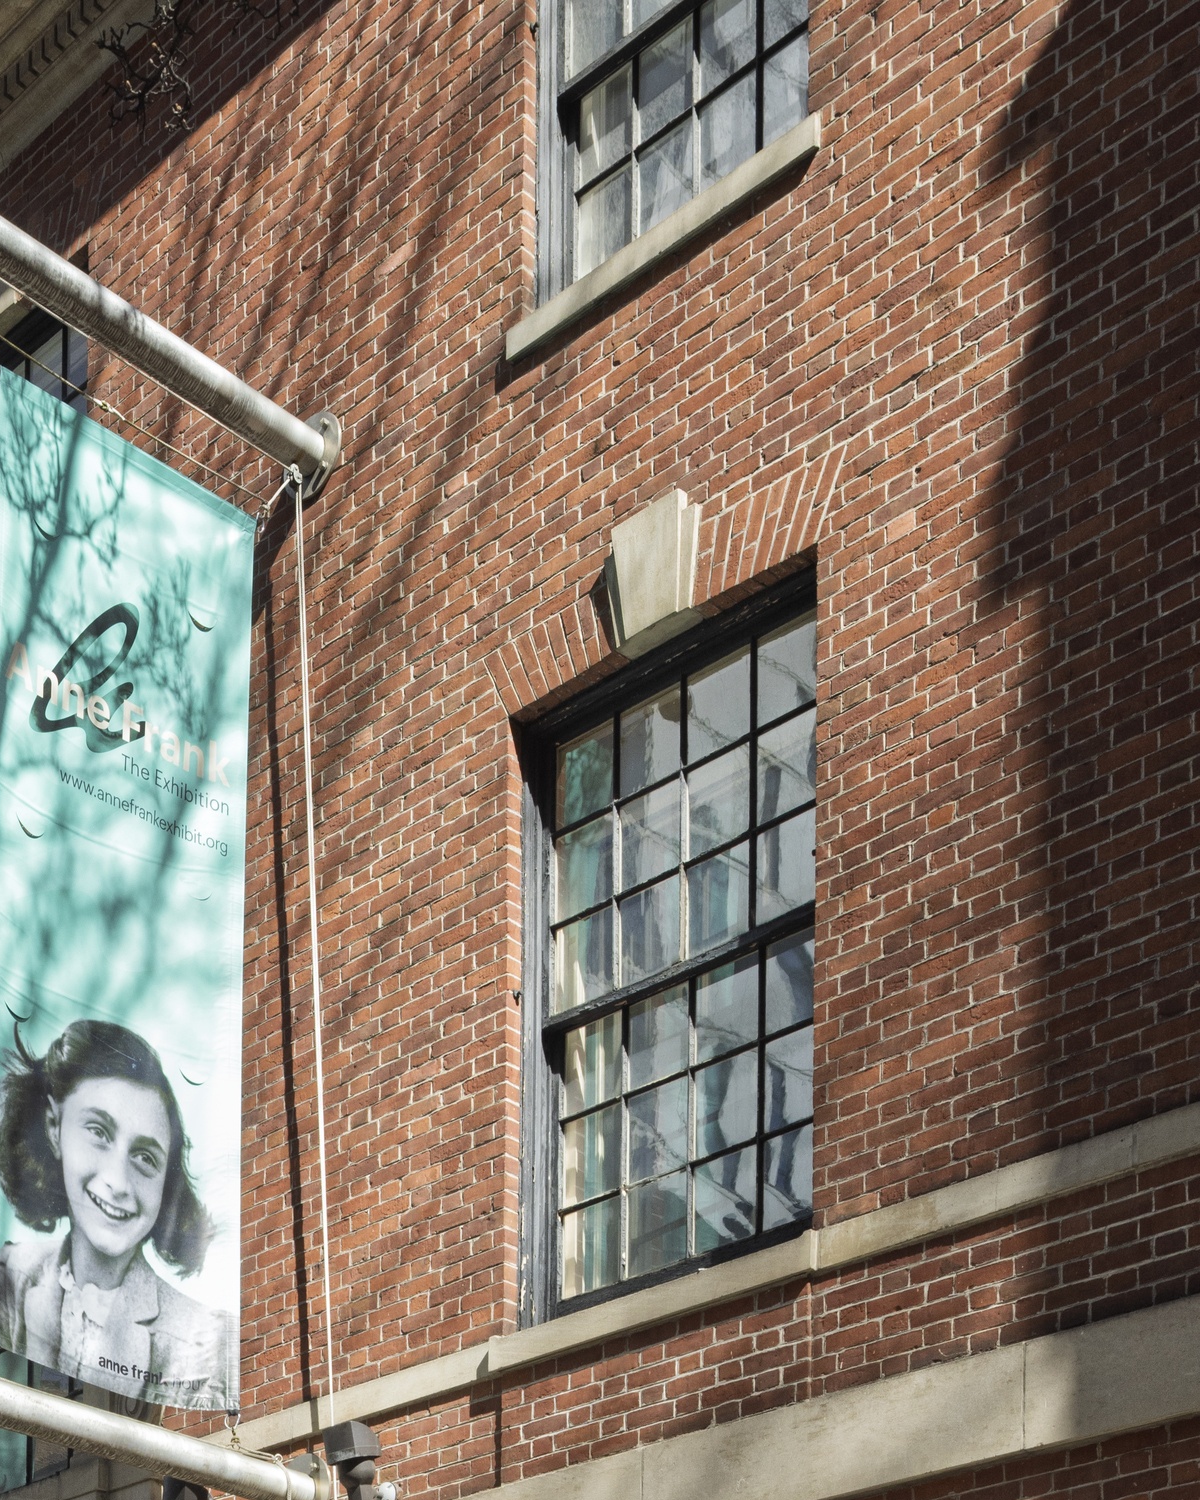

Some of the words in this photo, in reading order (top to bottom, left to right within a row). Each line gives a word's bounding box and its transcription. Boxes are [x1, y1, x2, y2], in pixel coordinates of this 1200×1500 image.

[5, 641, 110, 730] Anne
[121, 699, 231, 788] Frank
[59, 769, 228, 856] www.annefrankexhibit.org
[121, 753, 150, 781] The
[155, 770, 230, 816] Exhibition
[98, 1356, 128, 1376] anne
